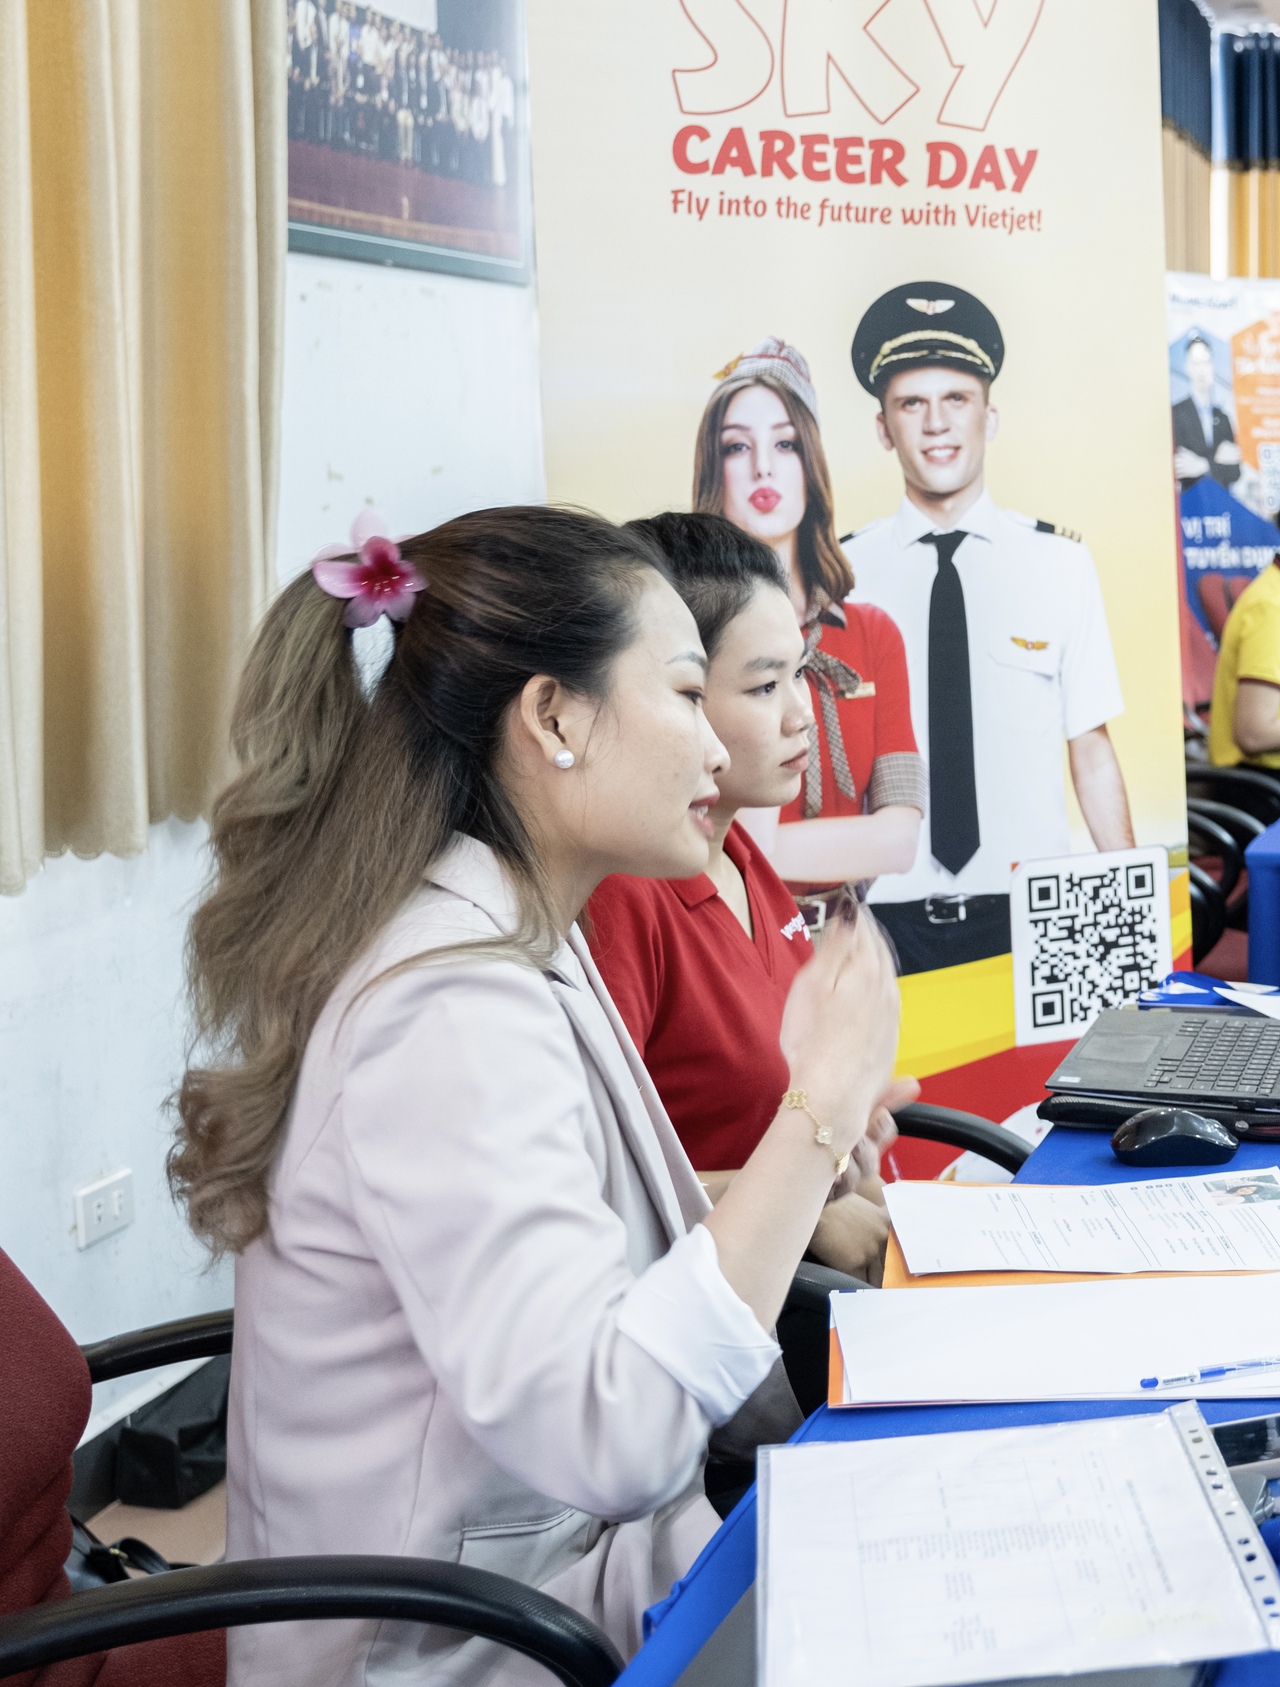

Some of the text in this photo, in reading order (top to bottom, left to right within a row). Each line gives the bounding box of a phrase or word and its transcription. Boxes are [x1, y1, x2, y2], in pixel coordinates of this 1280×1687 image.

[672, 0, 1045, 132] SKY
[672, 125, 1038, 193] CAREER DAY
[671, 189, 1042, 235] Fly into the future with Vietjet!
[1202, 511, 1231, 539] TRÍ
